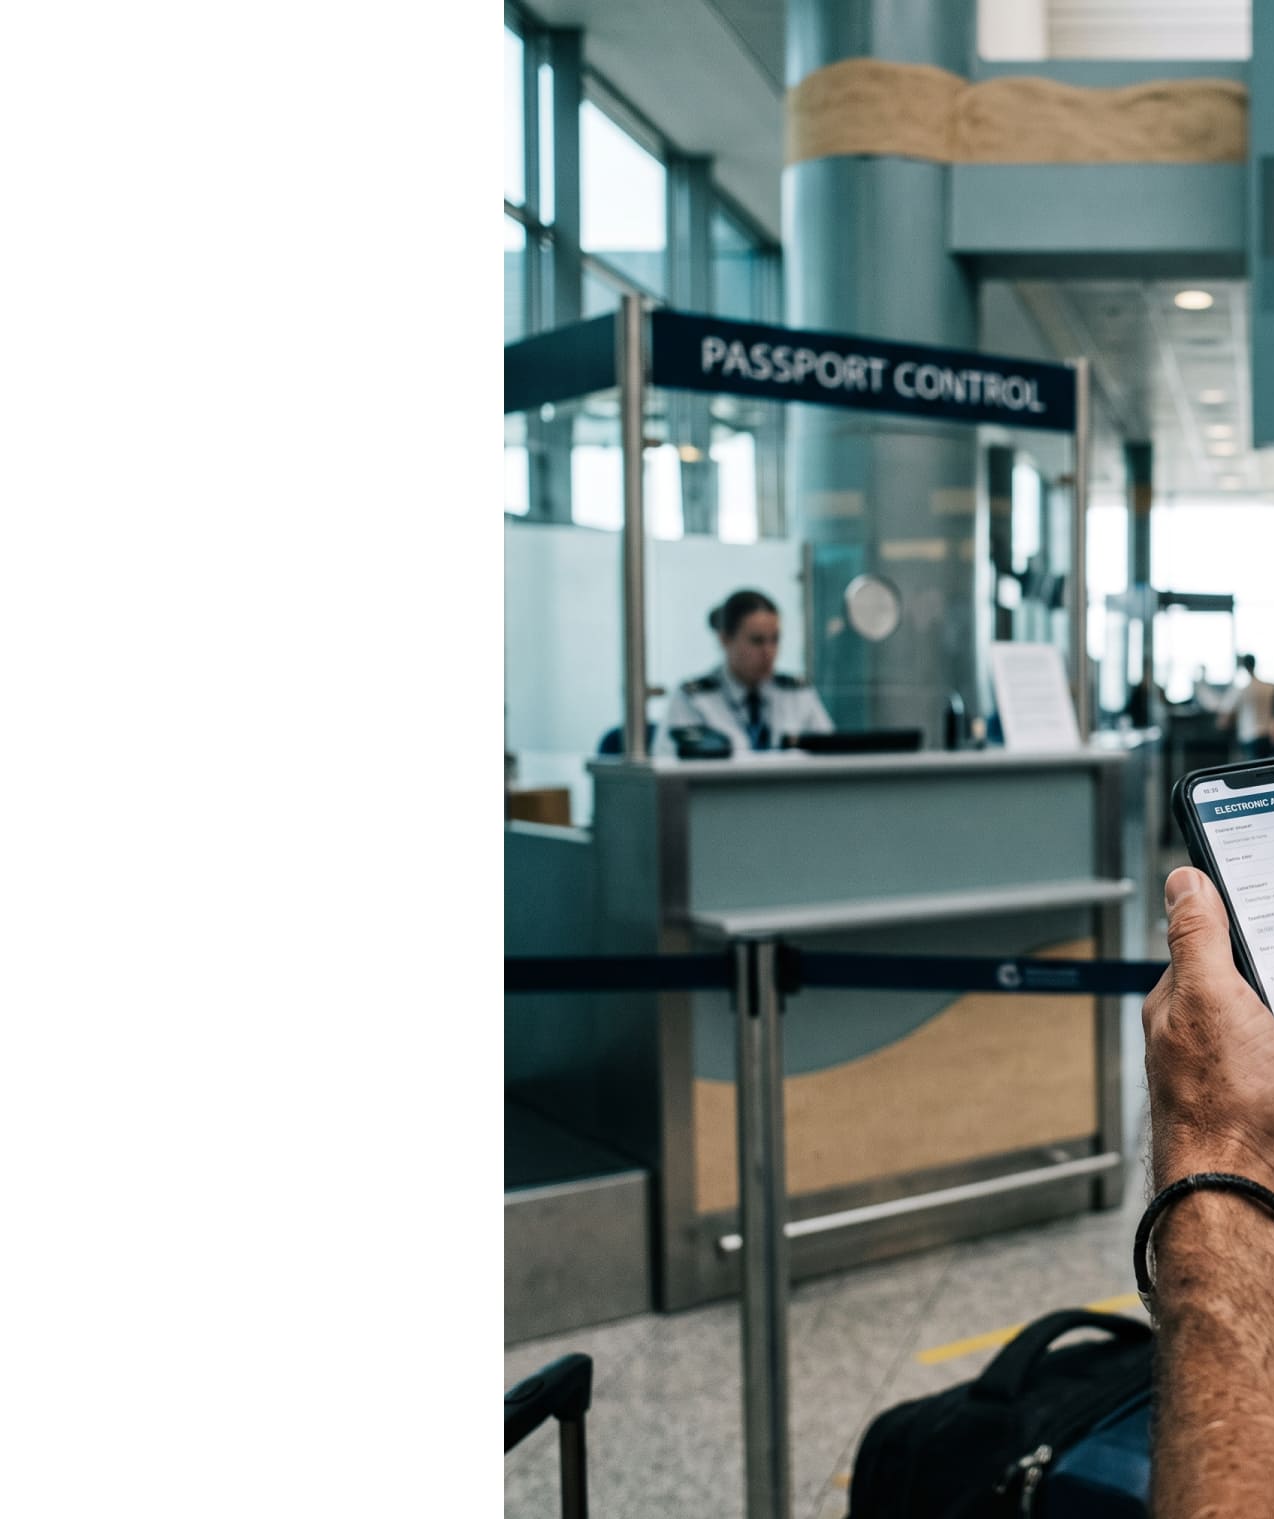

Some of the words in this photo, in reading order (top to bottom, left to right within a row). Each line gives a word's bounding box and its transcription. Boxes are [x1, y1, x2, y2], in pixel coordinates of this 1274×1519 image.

[701, 336, 889, 393] PASSPORT
[893, 362, 1047, 413] CONTROL
[1214, 799, 1269, 815] ELECTRONIC
